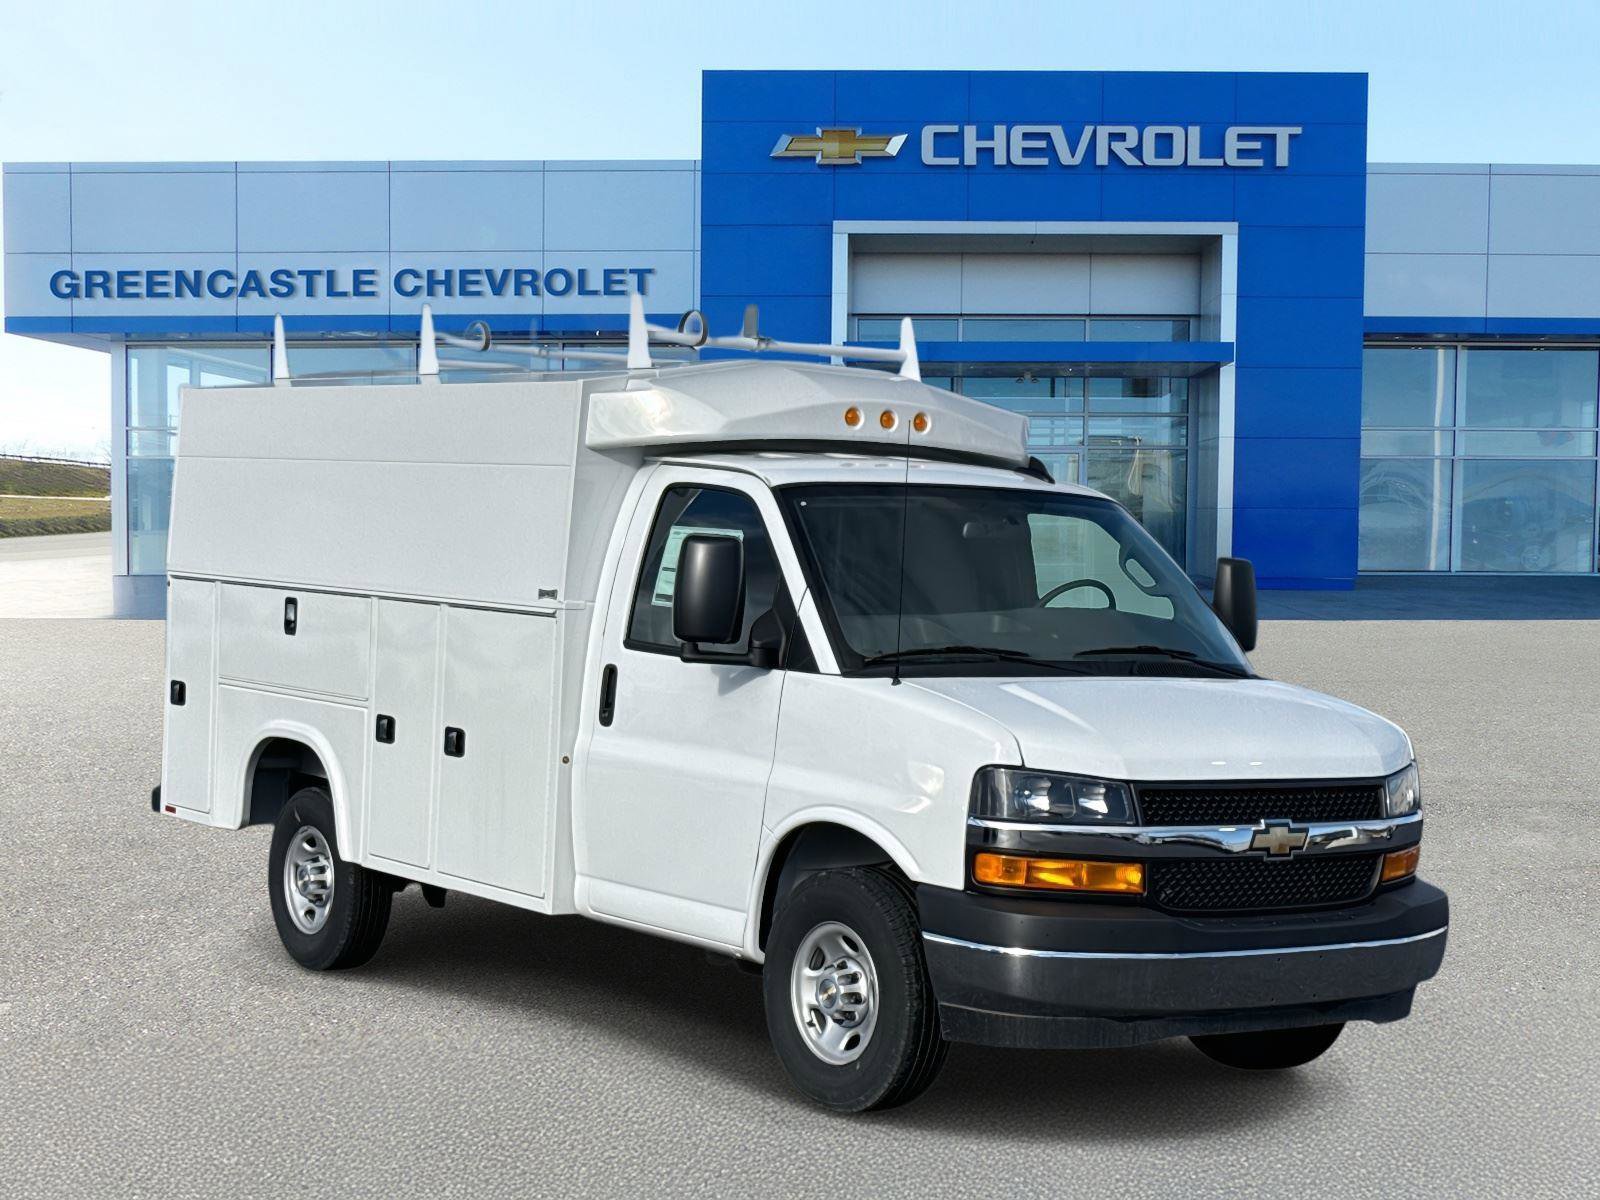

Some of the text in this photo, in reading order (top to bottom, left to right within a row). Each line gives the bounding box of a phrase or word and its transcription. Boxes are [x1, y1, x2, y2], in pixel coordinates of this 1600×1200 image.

[921, 124, 1303, 167] CHEVROLET
[49, 267, 655, 299] GREENCASTLE CHEVROLET
